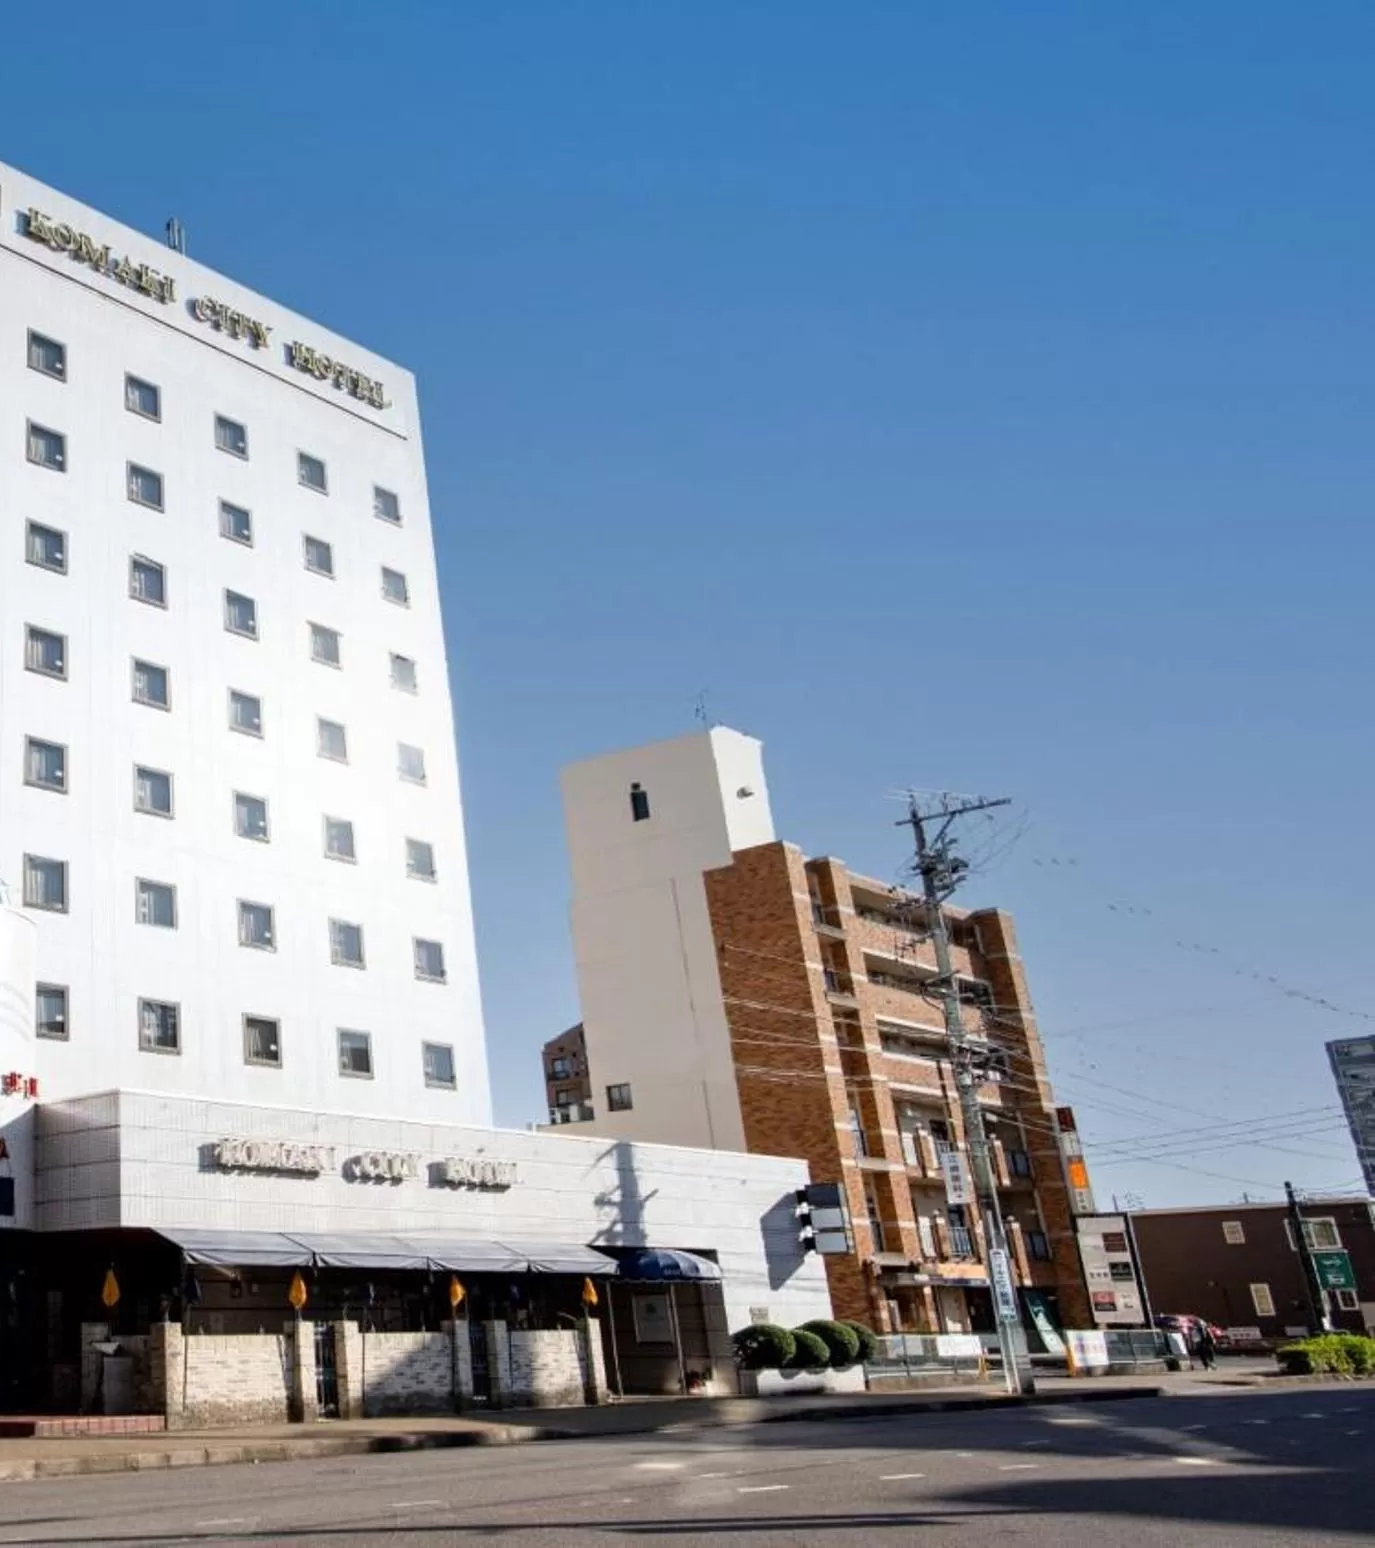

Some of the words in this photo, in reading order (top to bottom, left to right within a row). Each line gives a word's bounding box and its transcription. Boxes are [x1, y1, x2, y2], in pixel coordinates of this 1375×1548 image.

[27, 206, 177, 303] KOMAKI
[194, 295, 274, 349] CITY
[291, 340, 393, 410] HOTEL
